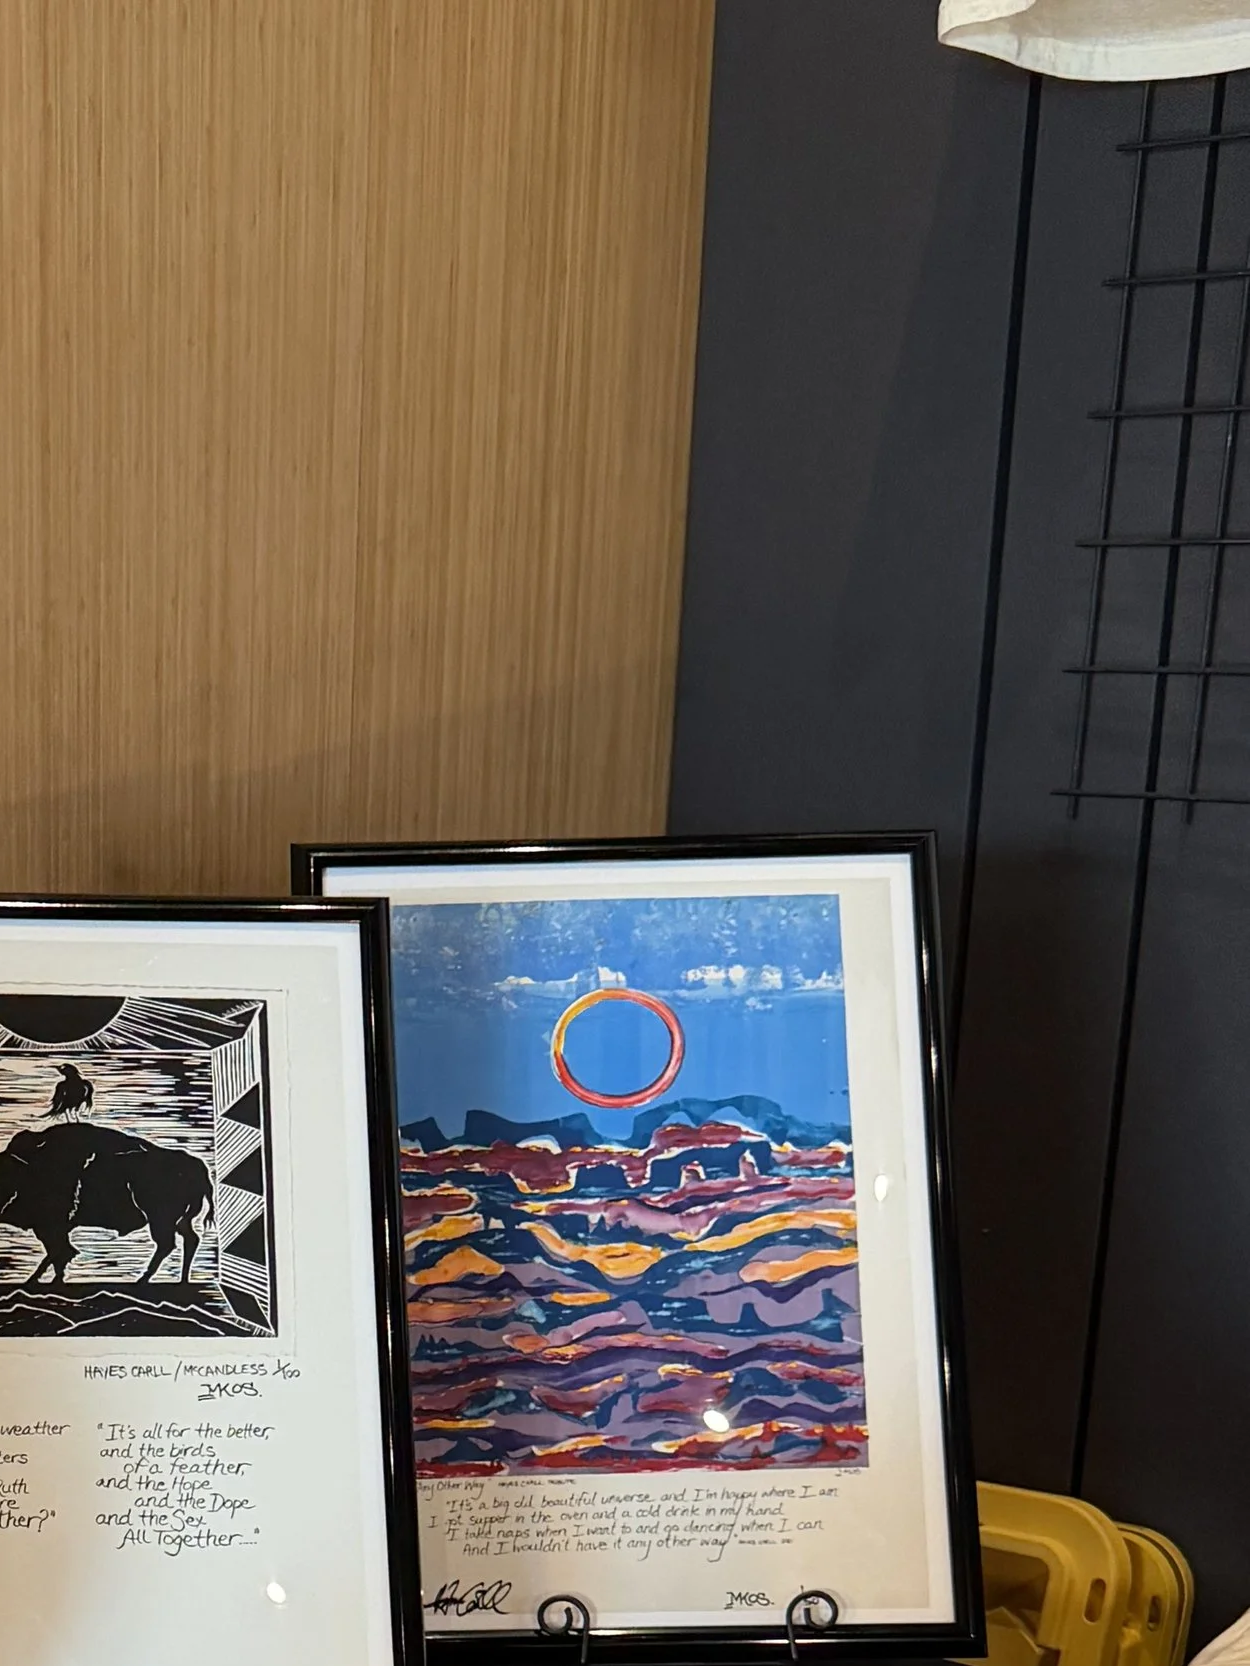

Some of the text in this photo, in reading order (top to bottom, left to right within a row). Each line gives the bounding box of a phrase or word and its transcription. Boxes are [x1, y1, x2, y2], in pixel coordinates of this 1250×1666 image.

[85, 1366, 171, 1378] HAYES CARLL
[0, 1422, 70, 1436] weather
[143, 1424, 162, 1439] all
[166, 1423, 190, 1438] for
[195, 1423, 222, 1438] the
[100, 1443, 216, 1458] and the birds
[124, 1458, 149, 1474] of
[150, 1464, 162, 1474] a
[96, 1475, 212, 1494] and the Hope
[135, 1493, 255, 1518] and the Dope
[541, 1492, 597, 1507] beautiful
[661, 1488, 686, 1502] and
[762, 1487, 795, 1498] where
[819, 1487, 839, 1497] am
[96, 1509, 206, 1531] and the Sex
[531, 1514, 554, 1524] the
[561, 1512, 588, 1520] oven
[592, 1507, 616, 1519] and
[706, 1506, 716, 1516] in
[746, 1502, 784, 1516] hand
[117, 1529, 151, 1549] All
[621, 1524, 632, 1535] to
[636, 1522, 659, 1534] and
[664, 1524, 679, 1539] go
[741, 1520, 774, 1532] when
[796, 1520, 825, 1530] can
[463, 1543, 489, 1556] And
[576, 1537, 608, 1550] have
[614, 1539, 622, 1548] it
[657, 1535, 697, 1549] other
